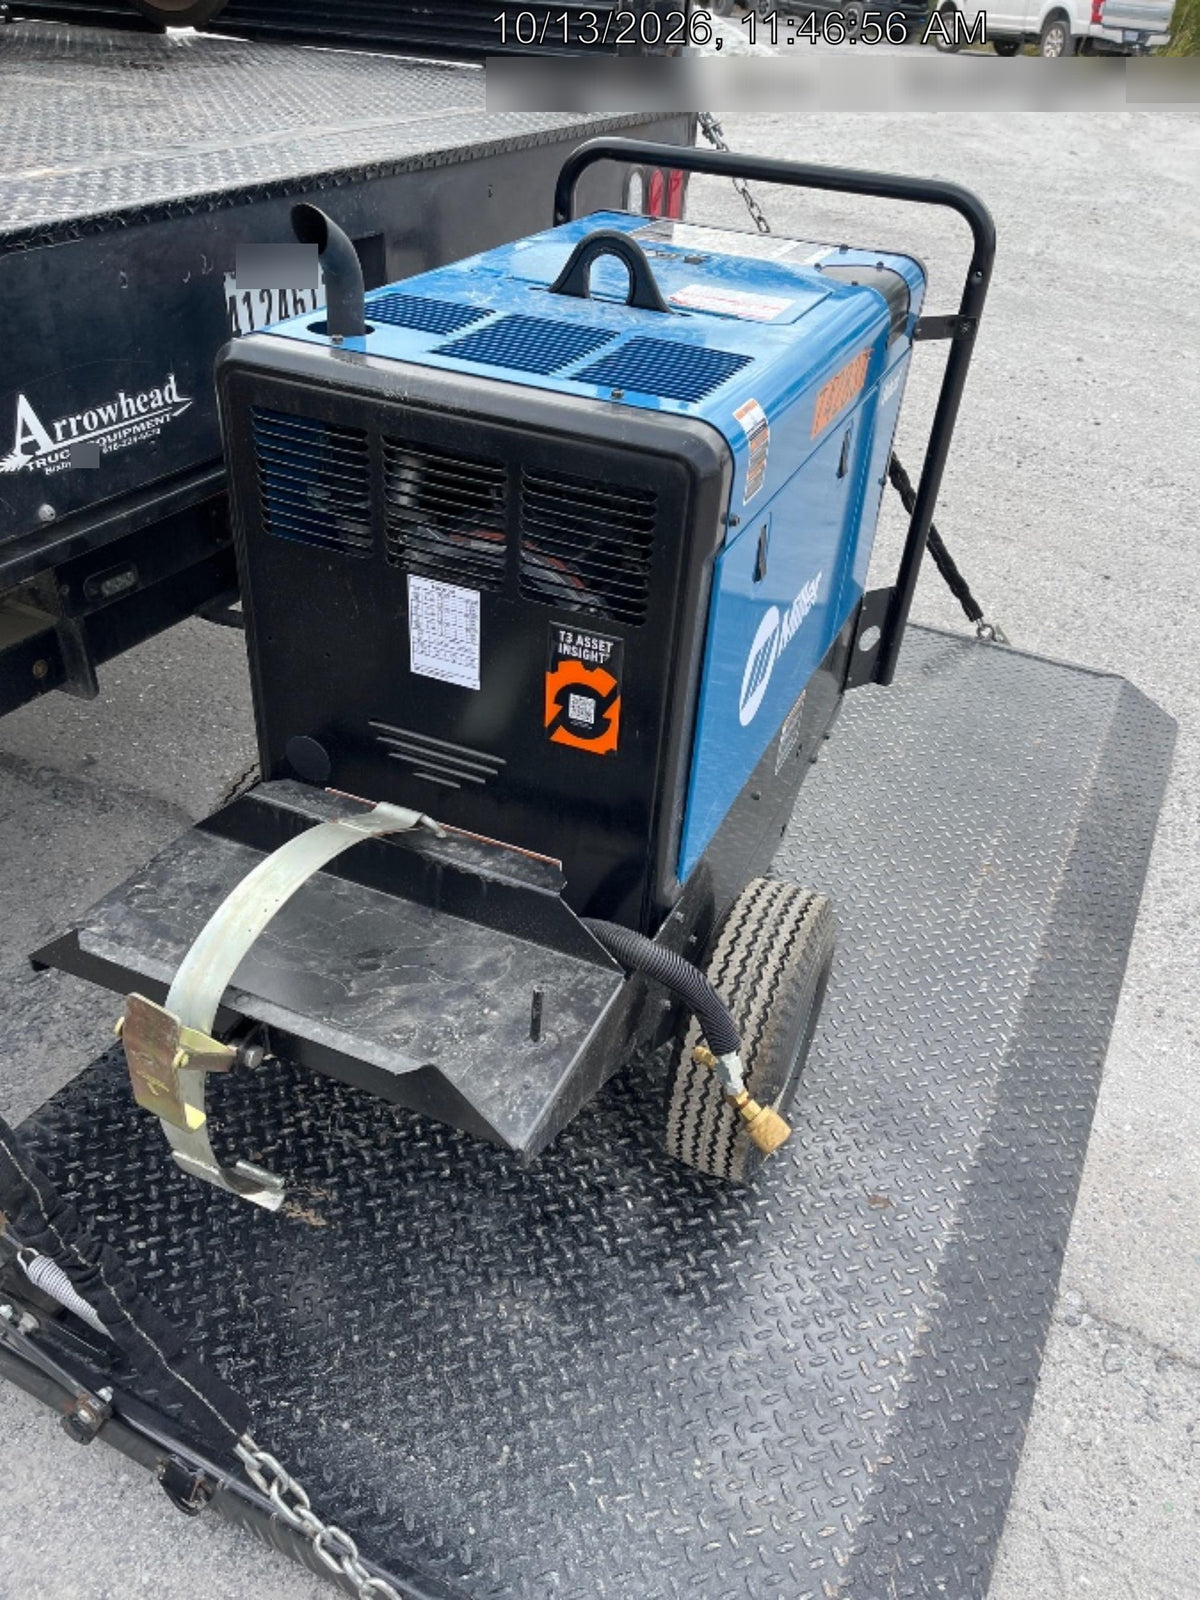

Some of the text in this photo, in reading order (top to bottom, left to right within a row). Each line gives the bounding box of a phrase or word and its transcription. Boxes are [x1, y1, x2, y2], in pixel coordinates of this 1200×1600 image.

[15, 374, 191, 458] Arrowhead
[27, 449, 72, 472] TRUC
[559, 630, 614, 654] T3 ASSET
